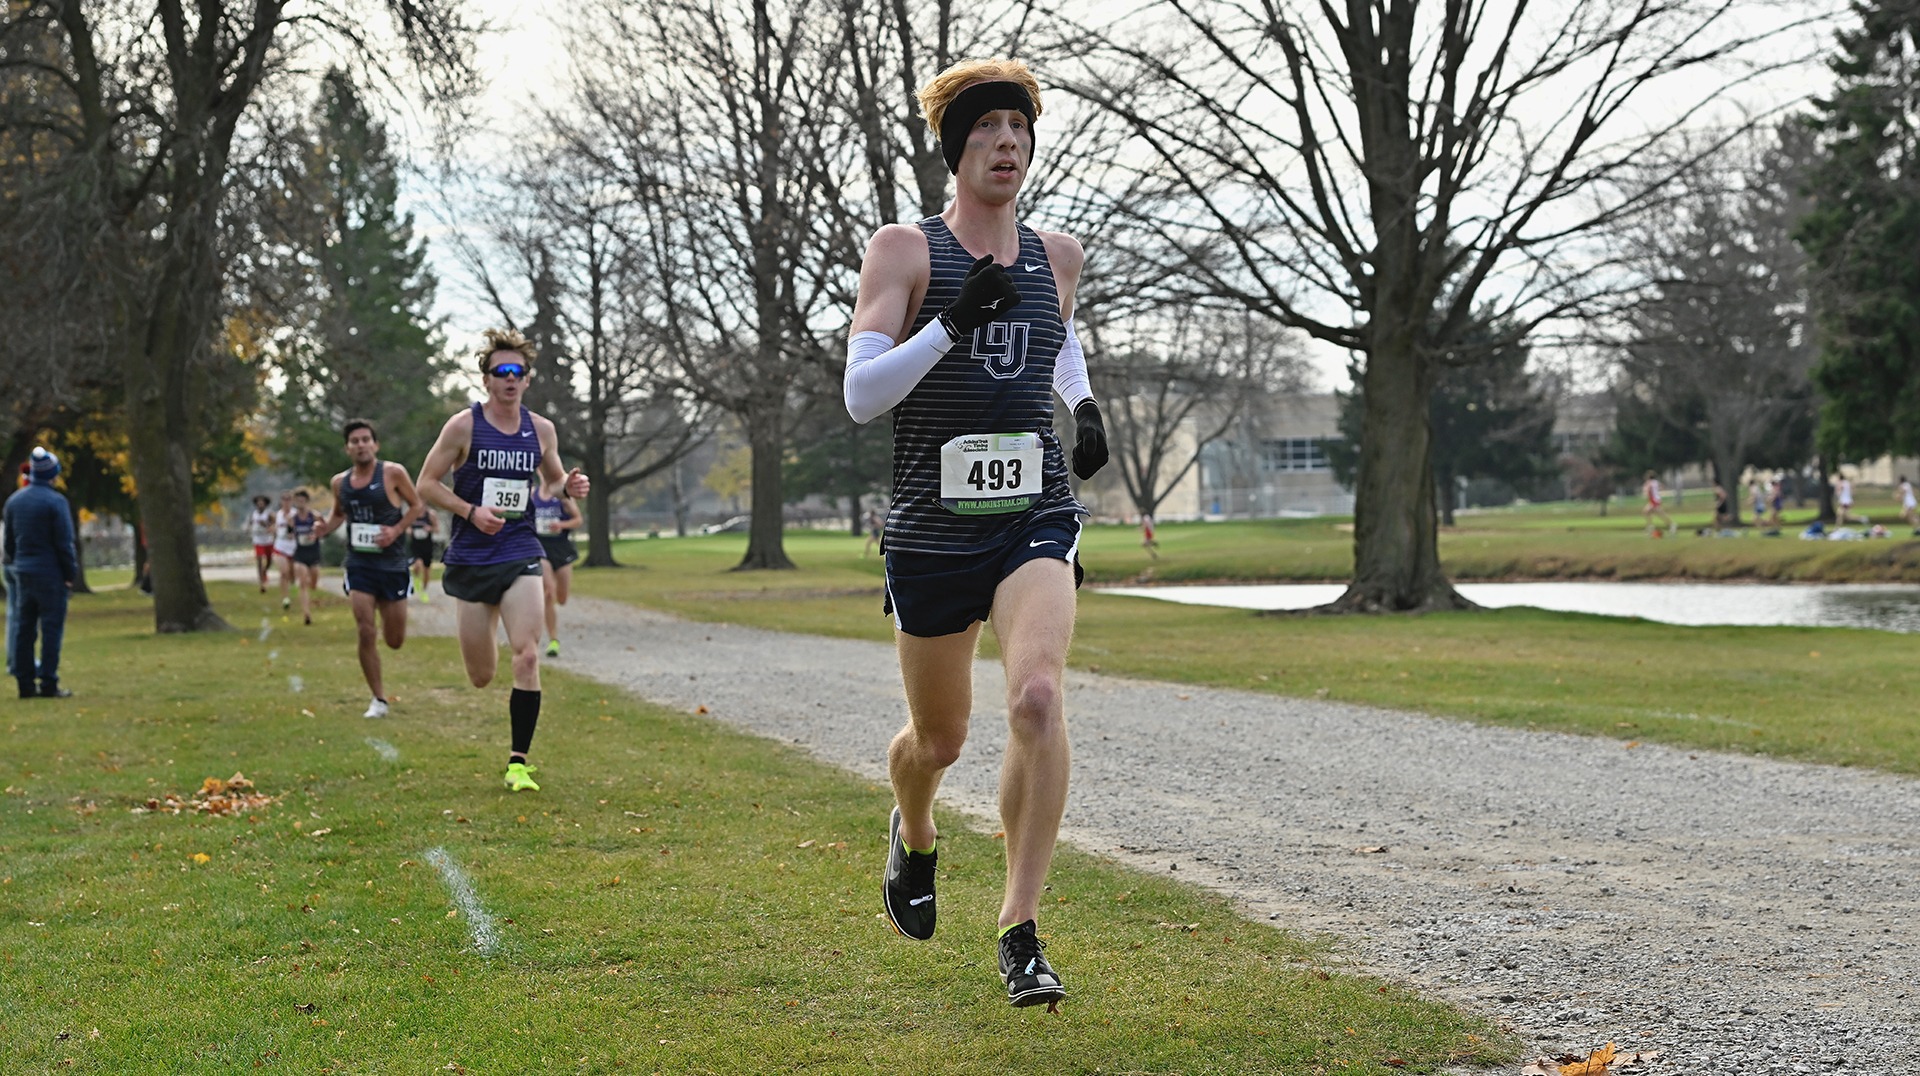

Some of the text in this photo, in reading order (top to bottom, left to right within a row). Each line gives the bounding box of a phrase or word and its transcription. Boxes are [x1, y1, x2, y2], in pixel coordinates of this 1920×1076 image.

[478, 449, 535, 472] CORNELL
[967, 458, 1023, 491] 493
[495, 491, 521, 507] 359
[957, 497, 1030, 509] WWW.ADKINSTRAK.COM
